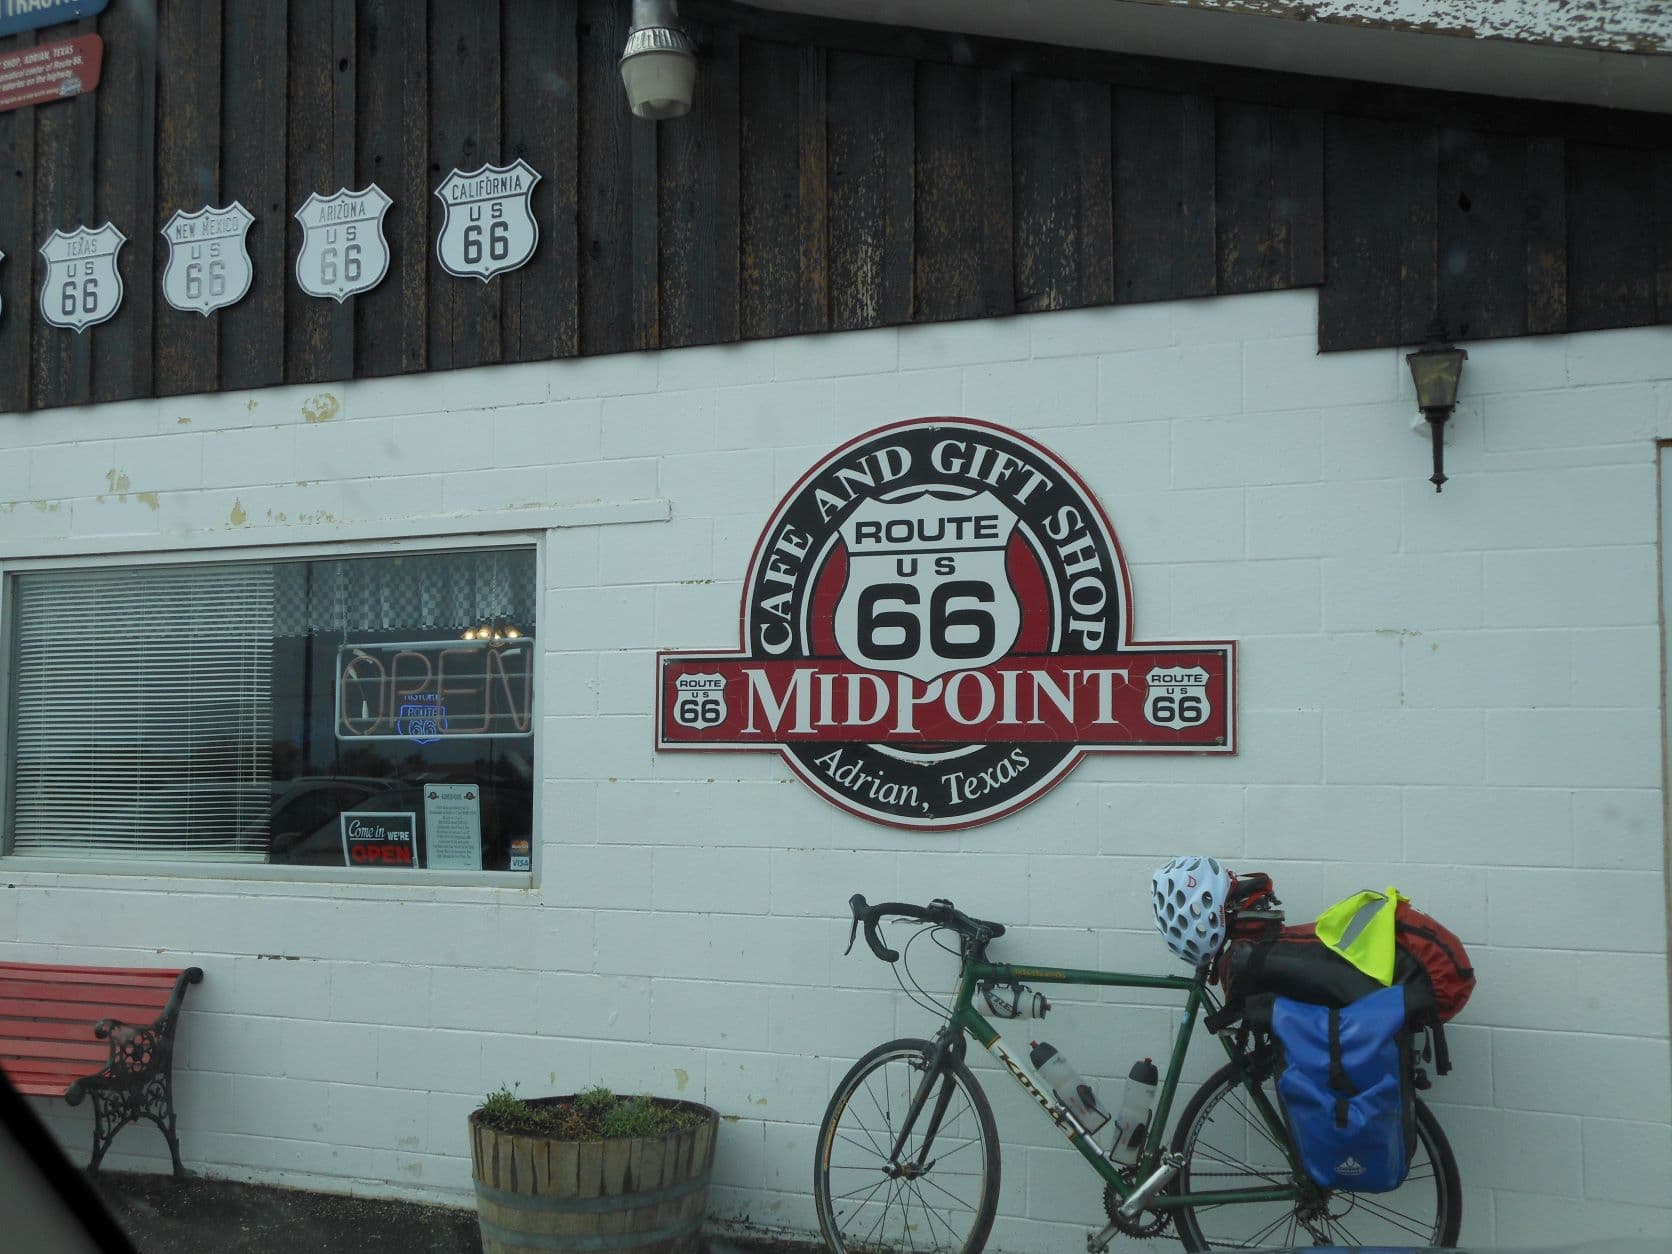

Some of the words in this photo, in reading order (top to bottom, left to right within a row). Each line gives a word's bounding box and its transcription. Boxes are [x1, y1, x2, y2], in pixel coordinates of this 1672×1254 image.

[452, 175, 522, 201] CALIFORNIA
[319, 201, 366, 223] ARIZONA
[176, 223, 195, 240] NEW
[201, 216, 239, 236] MEXICO
[66, 239, 97, 255] TEXAS
[463, 221, 509, 265] 66
[320, 243, 361, 285] 66
[186, 260, 225, 299] 66
[62, 278, 98, 316] 66
[855, 514, 999, 545] ROUTE
[760, 524, 814, 656] CAFE
[812, 445, 912, 524] AND
[931, 439, 1053, 506] GIFT
[1041, 505, 1107, 652] SHOP
[857, 580, 996, 661] 66
[680, 679, 722, 688] ROUTE
[1151, 674, 1203, 683] ROUTE
[341, 648, 532, 736] OPEN
[741, 668, 1129, 734] MIDPOINT
[679, 699, 721, 724] 66
[1152, 696, 1202, 723] 66
[408, 718, 437, 736] 66
[814, 748, 930, 812] Adrian,
[942, 747, 1030, 805] Texas
[348, 819, 374, 837] Come
[374, 823, 385, 838] in
[387, 831, 410, 841] WE'RE
[351, 843, 411, 863] OPEN
[512, 858, 529, 867] VISA
